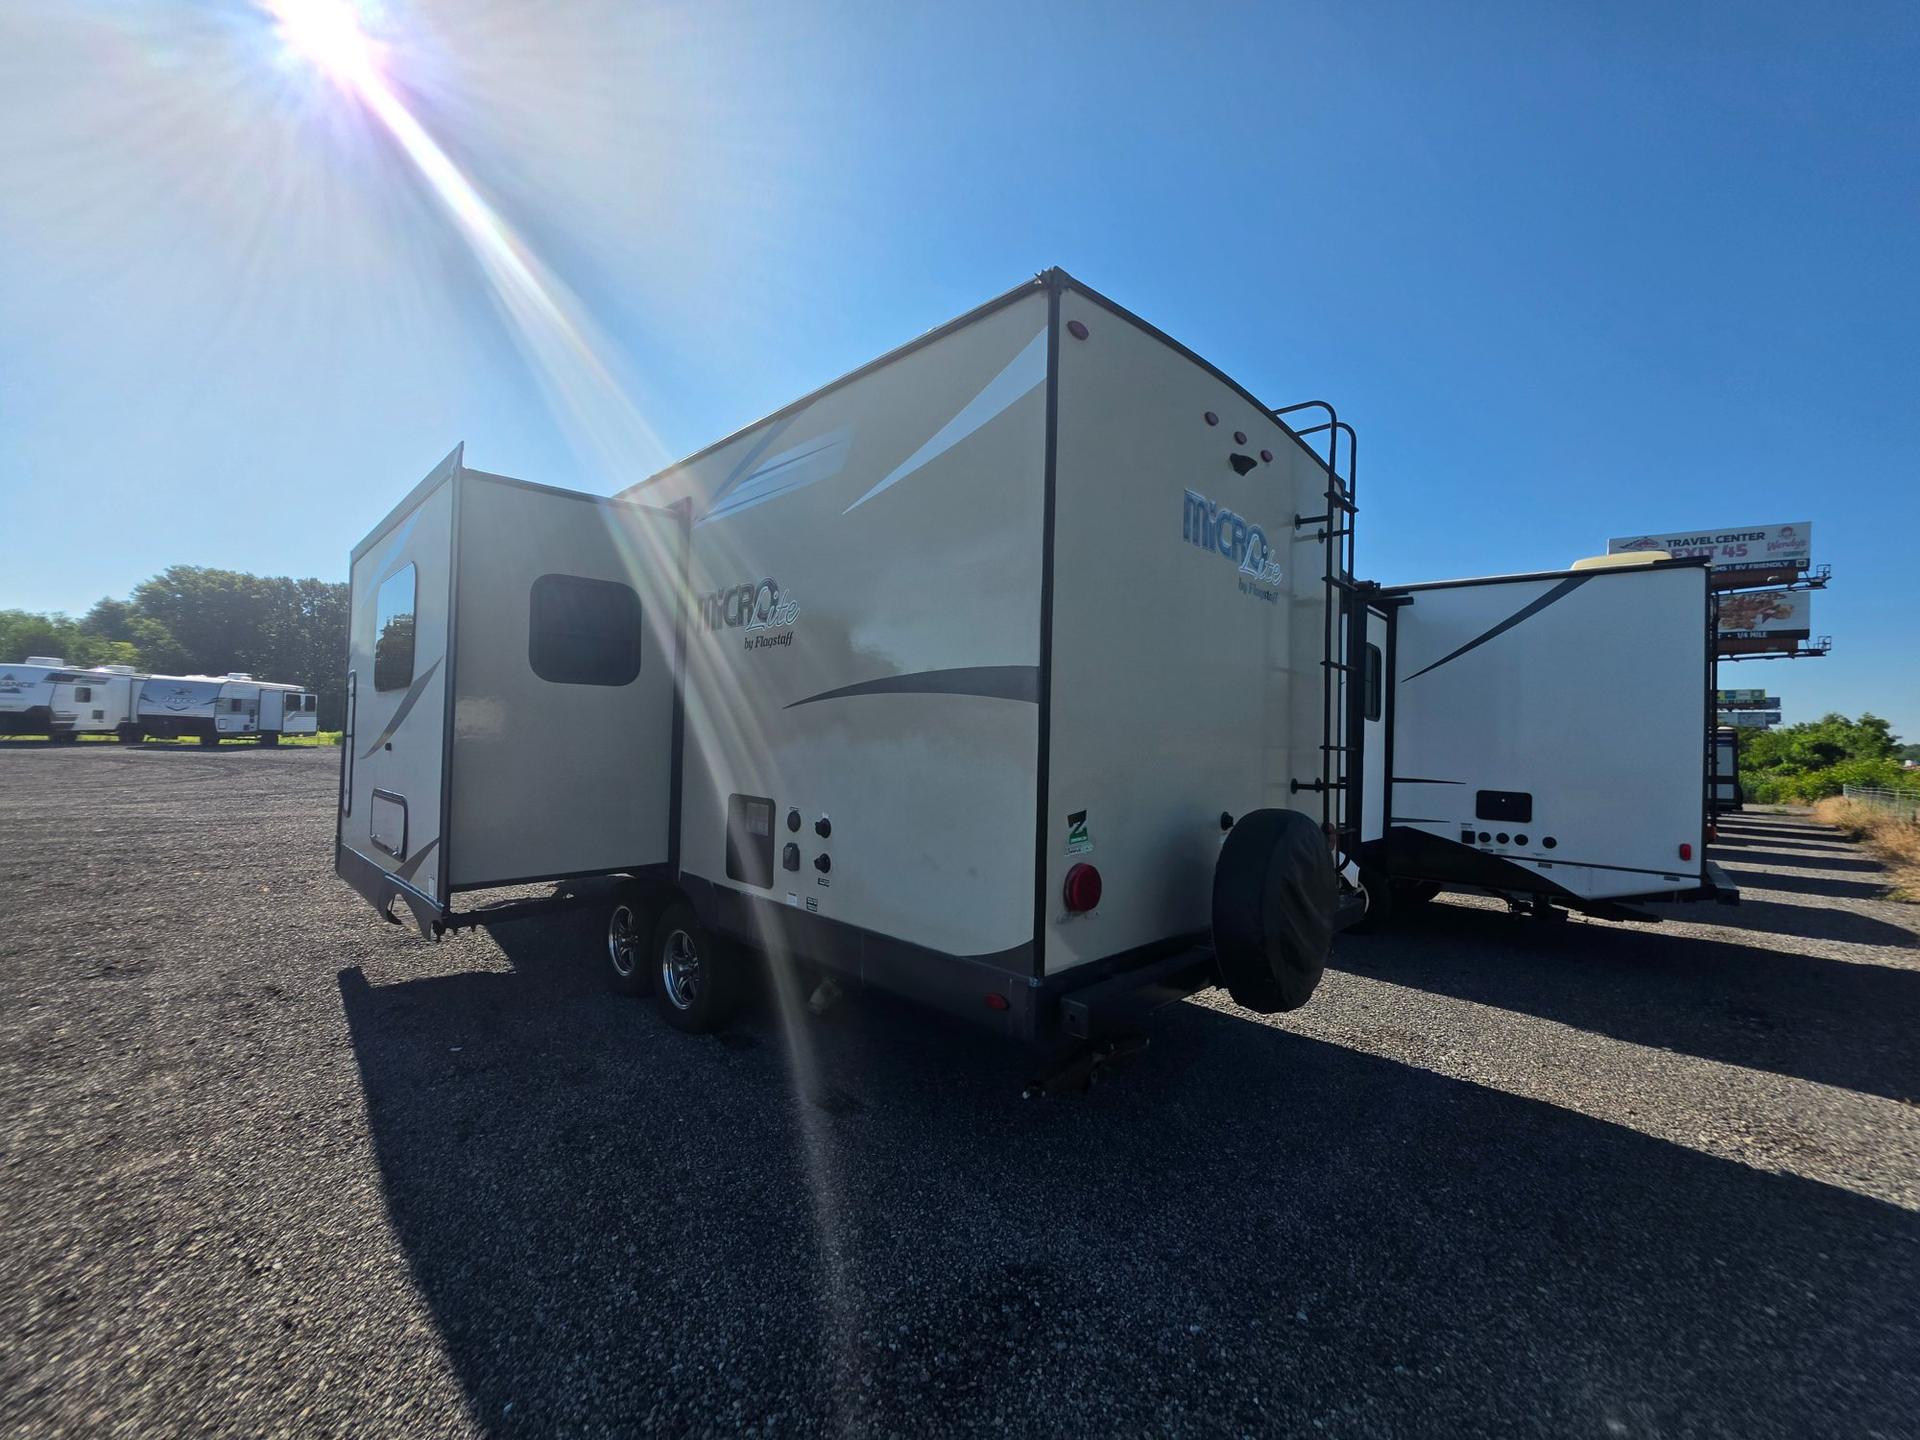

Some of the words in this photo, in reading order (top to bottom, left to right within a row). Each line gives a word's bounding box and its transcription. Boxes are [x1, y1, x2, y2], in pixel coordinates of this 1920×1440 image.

[1666, 535, 1714, 548] TRAVEL
[1715, 531, 1766, 544] CENTER
[1238, 532, 1283, 586] Lite
[1670, 545, 1718, 560] EXIT
[1722, 543, 1749, 558] 45
[1748, 560, 1790, 570] FRIENDLY
[744, 588, 801, 633] Lite
[744, 637, 754, 652] by
[754, 630, 794, 650] Flagstaff
[1749, 631, 1768, 639] MILE
